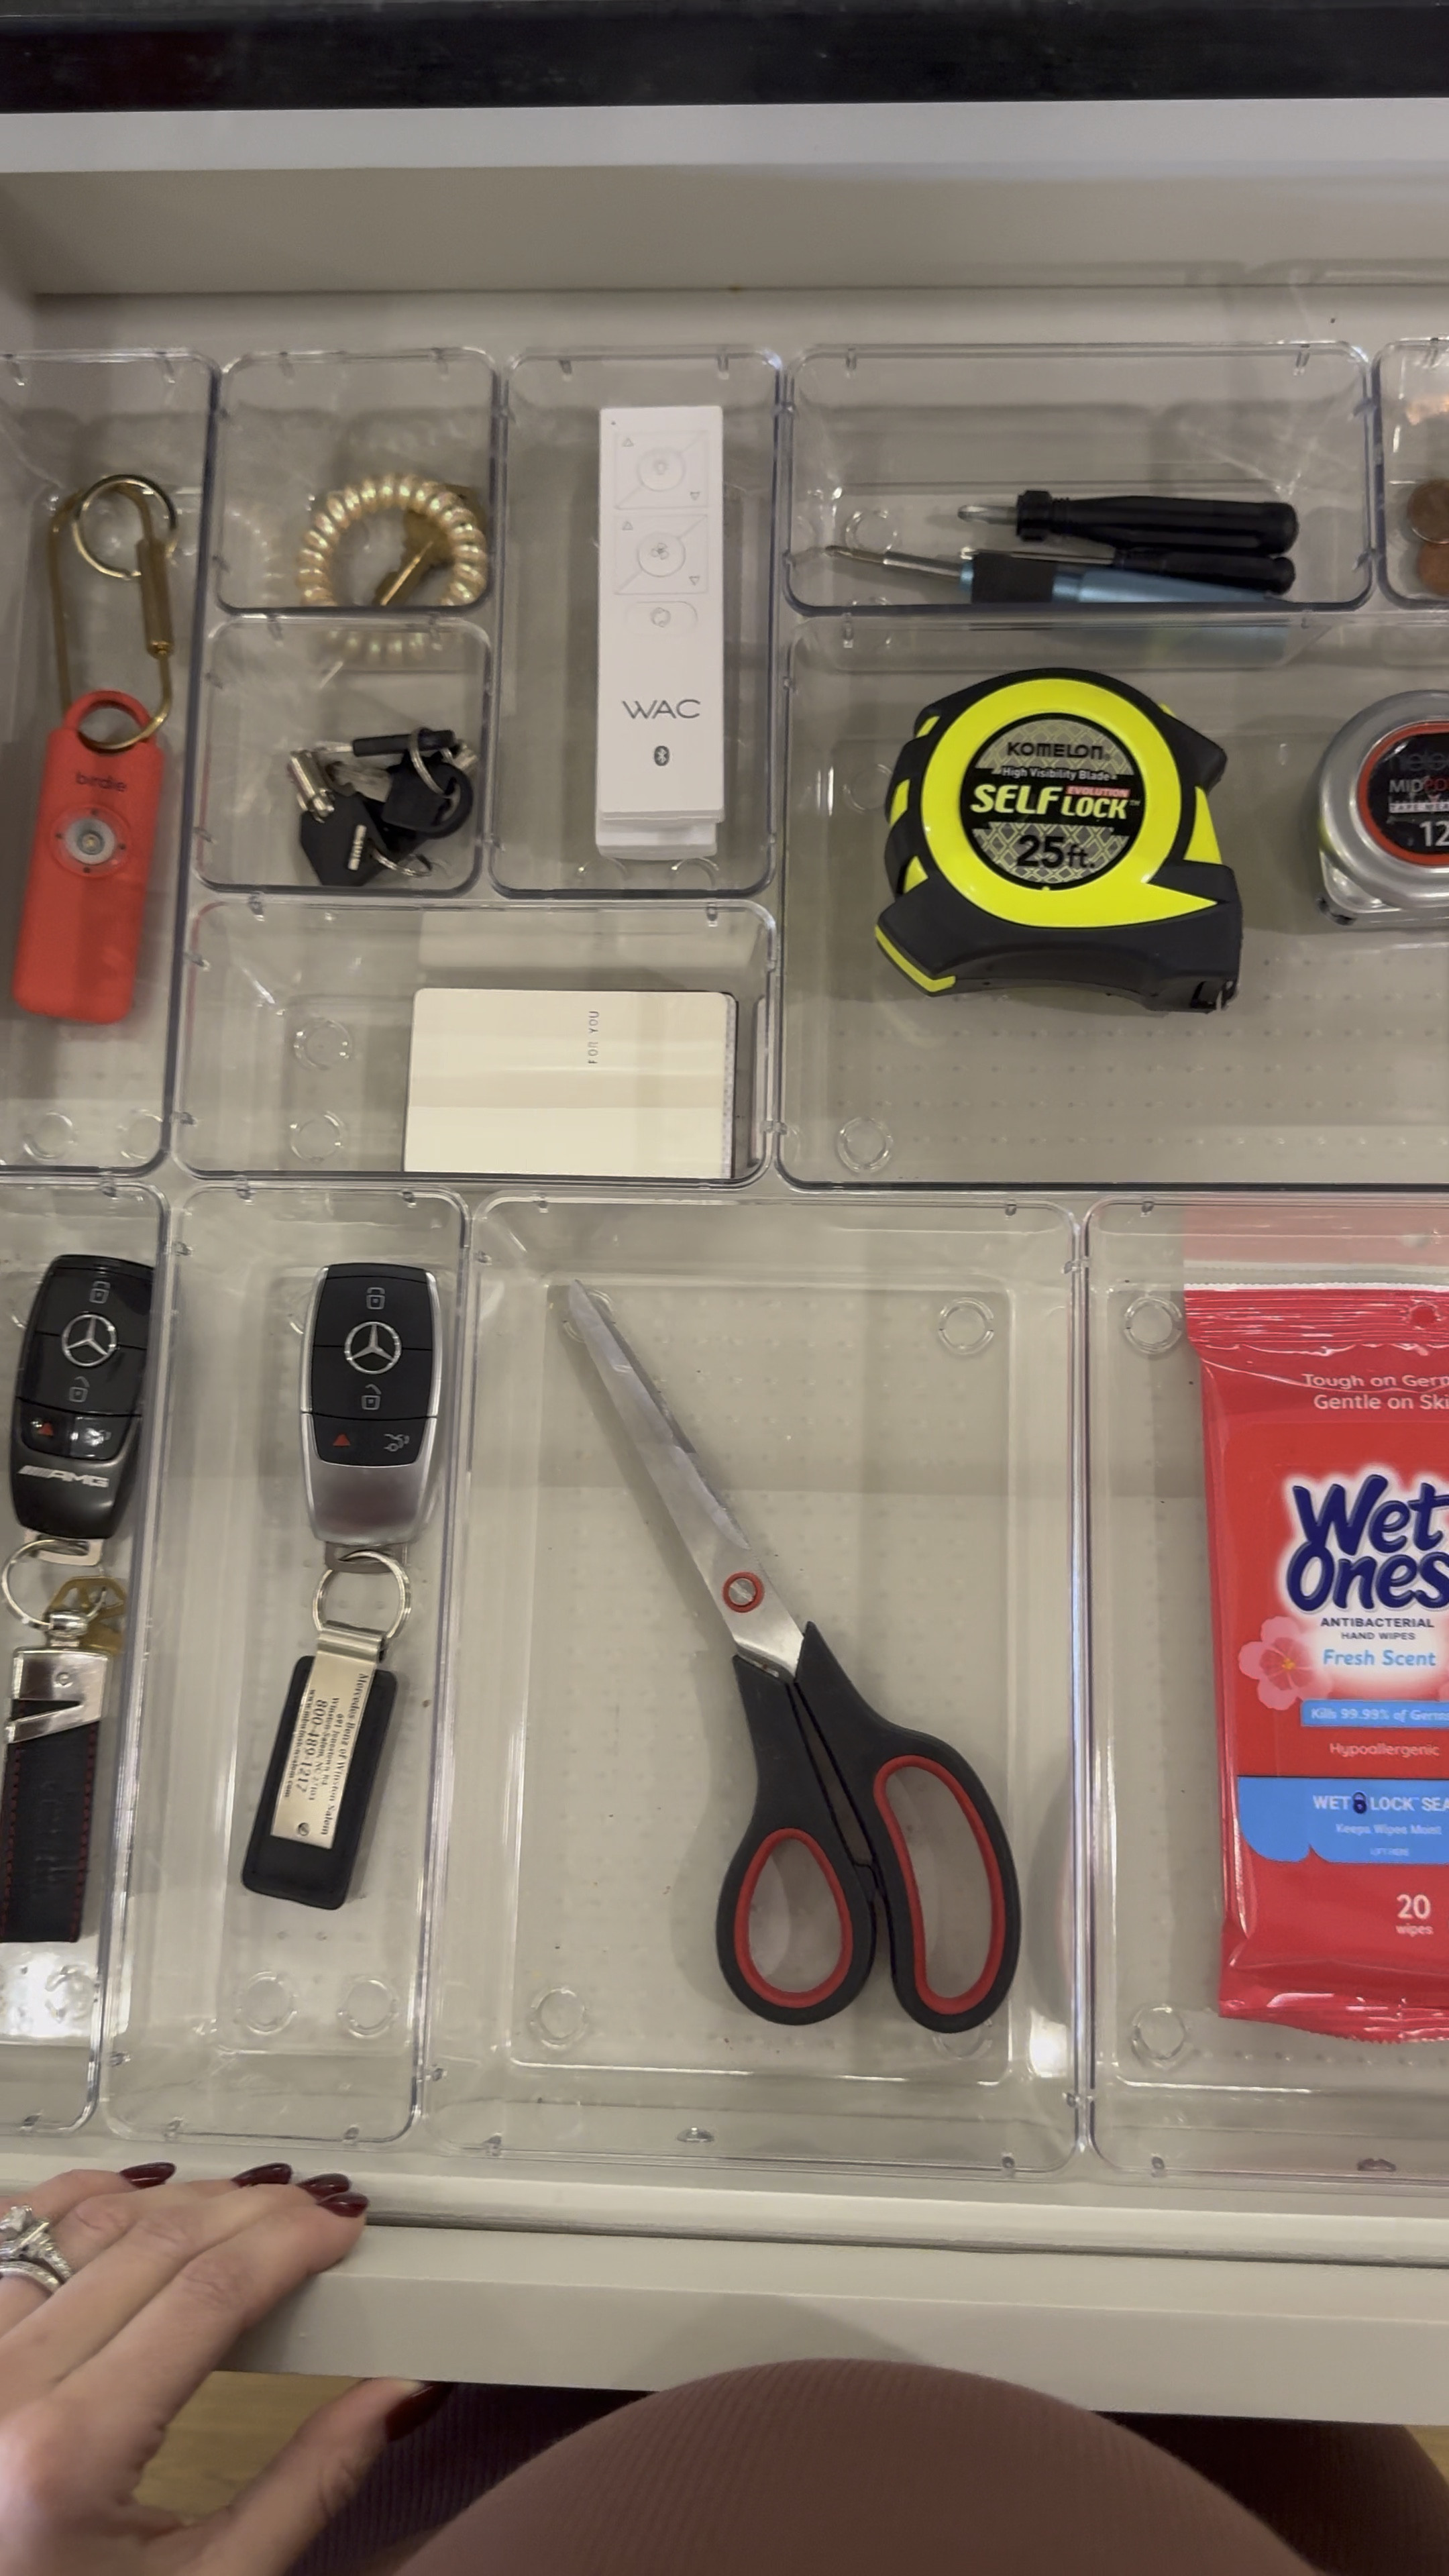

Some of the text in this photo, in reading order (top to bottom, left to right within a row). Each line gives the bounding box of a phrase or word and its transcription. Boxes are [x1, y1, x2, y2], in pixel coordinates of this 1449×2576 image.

[622, 699, 700, 719] WAC
[1008, 742, 1104, 759] KOMELON
[1002, 766, 1110, 781] High Visibility Blade
[1066, 786, 1130, 797] EVOLUTION
[1389, 778, 1449, 794] MIDPO
[971, 784, 1128, 819] SELF LOCK
[588, 1010, 600, 1064] FOR YOU
[1301, 1373, 1364, 1389] Tough
[1370, 1375, 1397, 1387] on
[1313, 1394, 1381, 1409] Gentle
[1387, 1397, 1413, 1409] on
[49, 1469, 109, 1487] AMG
[1292, 1474, 1449, 1556] Wet
[1287, 1541, 1449, 1611] Ones
[1320, 1617, 1434, 1628] ANTIBACTERIAL
[1323, 1649, 1436, 1666] Fresh Scent
[1311, 1708, 1336, 1719] Kills
[1340, 1709, 1389, 1720] 99.99%
[1393, 1710, 1408, 1722] of
[338, 1748, 348, 1758] of
[1330, 1743, 1440, 1758] Hypoallergenic
[1313, 1795, 1351, 1810] WET
[1397, 1894, 1431, 1919] 20
[1395, 1923, 1434, 1937] wipes
